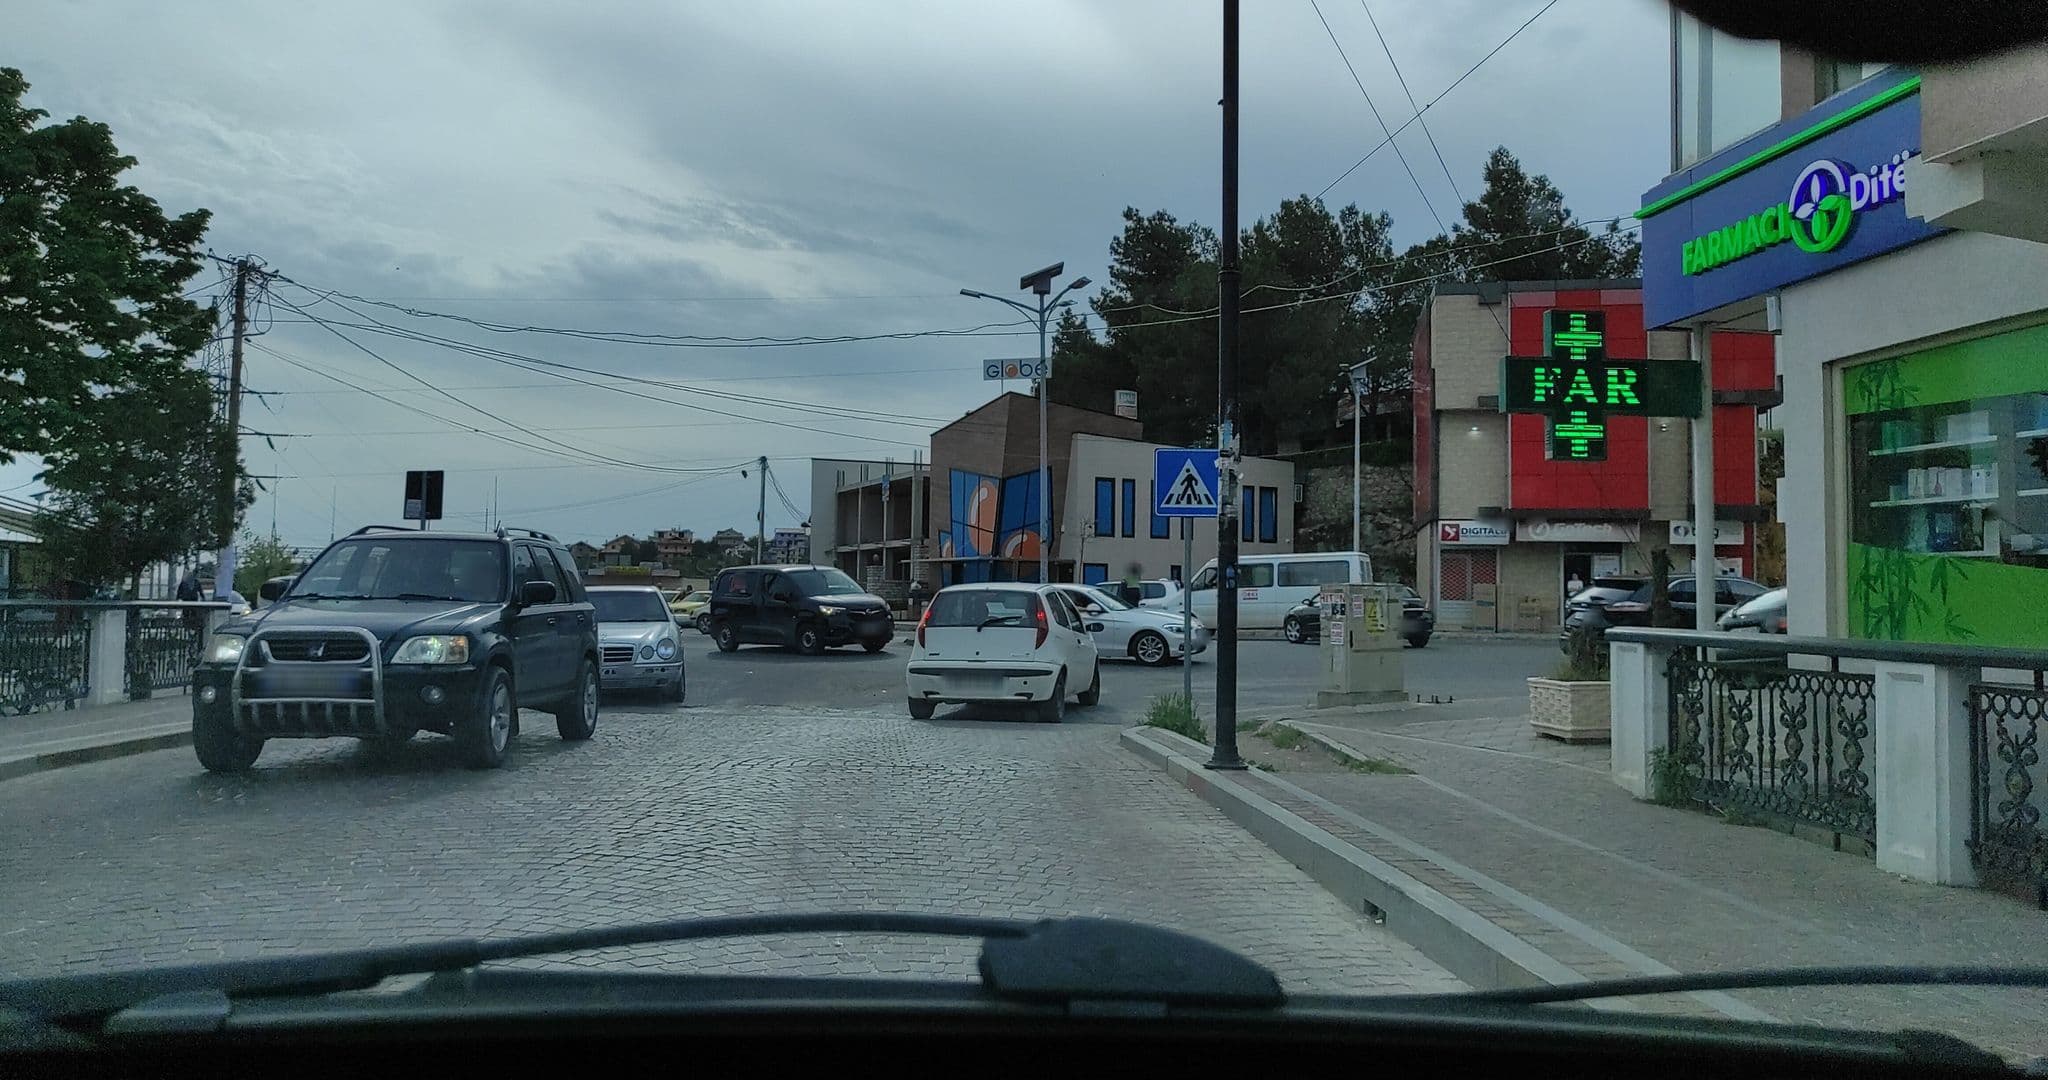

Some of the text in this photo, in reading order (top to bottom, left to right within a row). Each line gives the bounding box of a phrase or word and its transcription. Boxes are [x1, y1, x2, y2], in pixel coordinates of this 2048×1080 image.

[1682, 202, 1792, 276] FARMACI
[986, 360, 1048, 378] Globe
[1534, 367, 1640, 404] FAR
